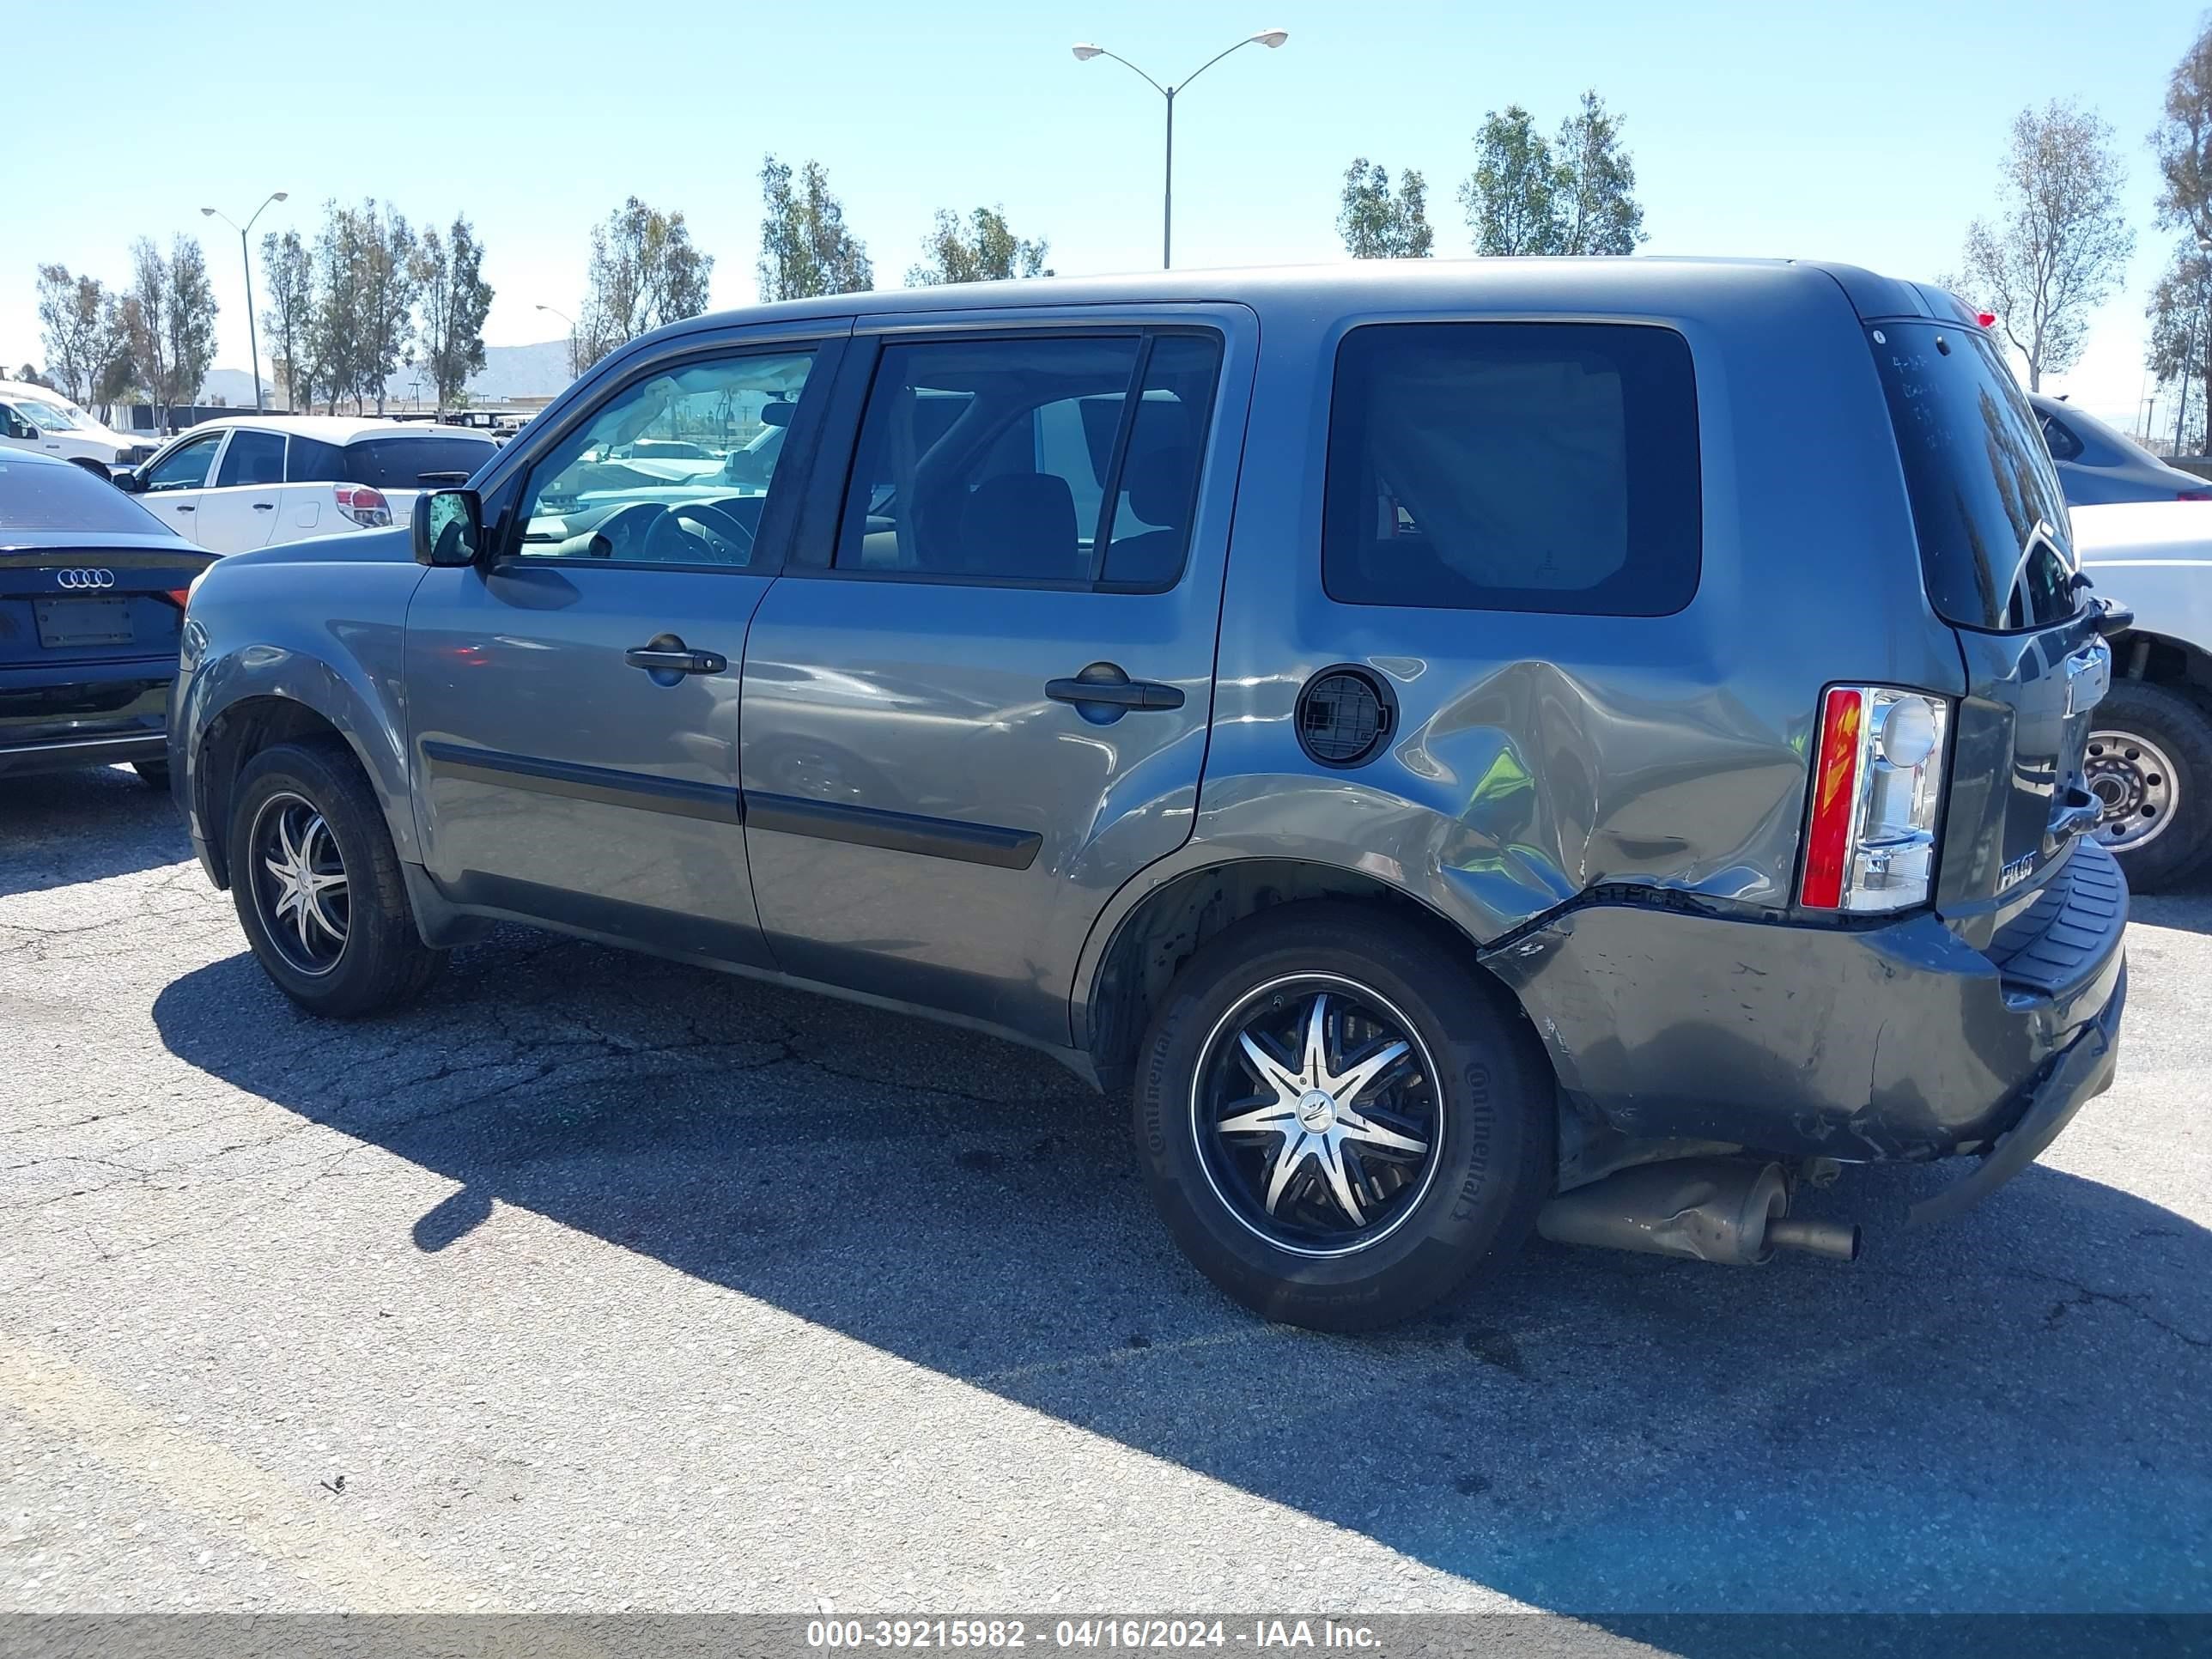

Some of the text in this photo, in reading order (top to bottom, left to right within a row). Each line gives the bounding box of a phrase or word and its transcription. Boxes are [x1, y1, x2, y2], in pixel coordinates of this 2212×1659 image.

[1997, 850, 2037, 890] PILOT
[1146, 1027, 1173, 1155] Continental
[1461, 1062, 1497, 1206] Continental
